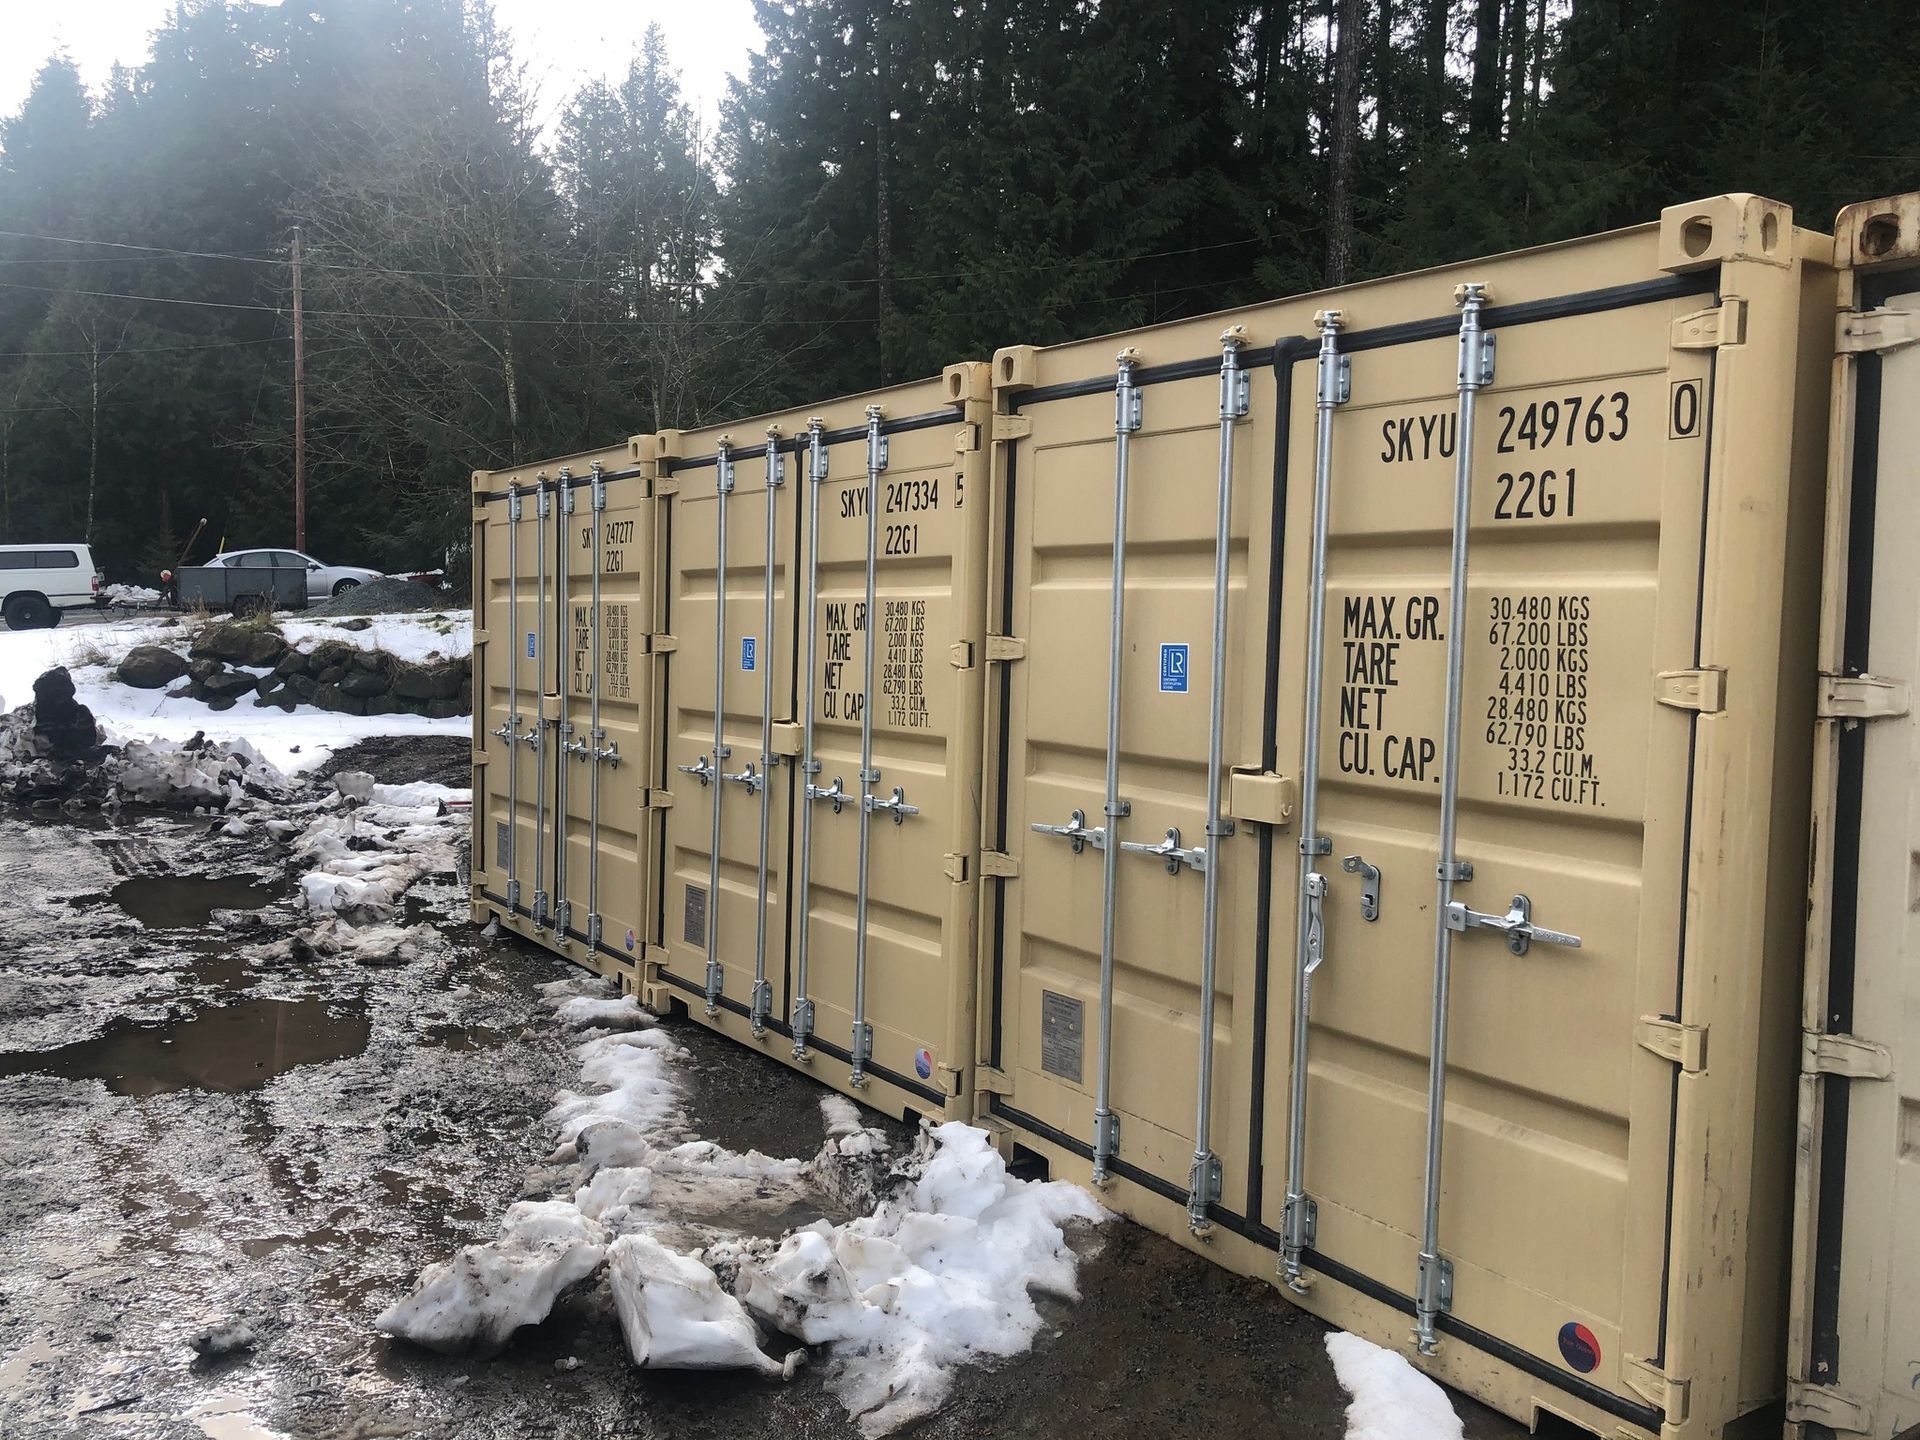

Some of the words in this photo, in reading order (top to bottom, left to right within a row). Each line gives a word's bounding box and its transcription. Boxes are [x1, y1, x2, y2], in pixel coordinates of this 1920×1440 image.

[1381, 412, 1456, 463] SKYU
[1497, 391, 1629, 454] 249763
[1674, 383, 1698, 435] 0
[886, 479, 938, 513] 247334
[1494, 468, 1575, 520] 22G1
[606, 521, 634, 544] 247277
[885, 524, 918, 555] 22G1
[606, 550, 623, 572] 22G1
[826, 603, 848, 631] MAX.
[911, 600, 925, 616] KGS
[1344, 596, 1401, 639] MAX.
[1406, 596, 1444, 640] GR.
[1490, 596, 1551, 620] 30,480
[1558, 596, 1590, 620] KGS
[911, 616, 925, 632] LBS
[1489, 622, 1550, 645] 67,200
[1557, 622, 1588, 647] LBS
[576, 628, 589, 649] TARE
[827, 633, 851, 660] TARE
[910, 632, 924, 648] KGS
[575, 651, 585, 671] NET
[910, 648, 924, 664] LBS
[1343, 642, 1400, 685] TARE
[1500, 647, 1550, 671] 2,000
[1557, 648, 1588, 672] KGS
[824, 662, 843, 690] NET
[909, 664, 923, 680] KGS
[1499, 672, 1549, 697] 4,410
[1556, 674, 1587, 699] LBS
[909, 680, 923, 696] LBS
[824, 691, 838, 719] CU.
[1340, 686, 1387, 731] NET
[1487, 696, 1548, 722] 28,480
[1555, 700, 1587, 725] KGS
[1486, 721, 1547, 748] 62,790
[1553, 725, 1585, 751] LBS
[1340, 731, 1374, 776] CU.
[1383, 735, 1439, 783] CAP.
[1508, 747, 1545, 774] 33.2
[1553, 751, 1597, 780] CU.M.
[1498, 771, 1544, 799] 1,172
